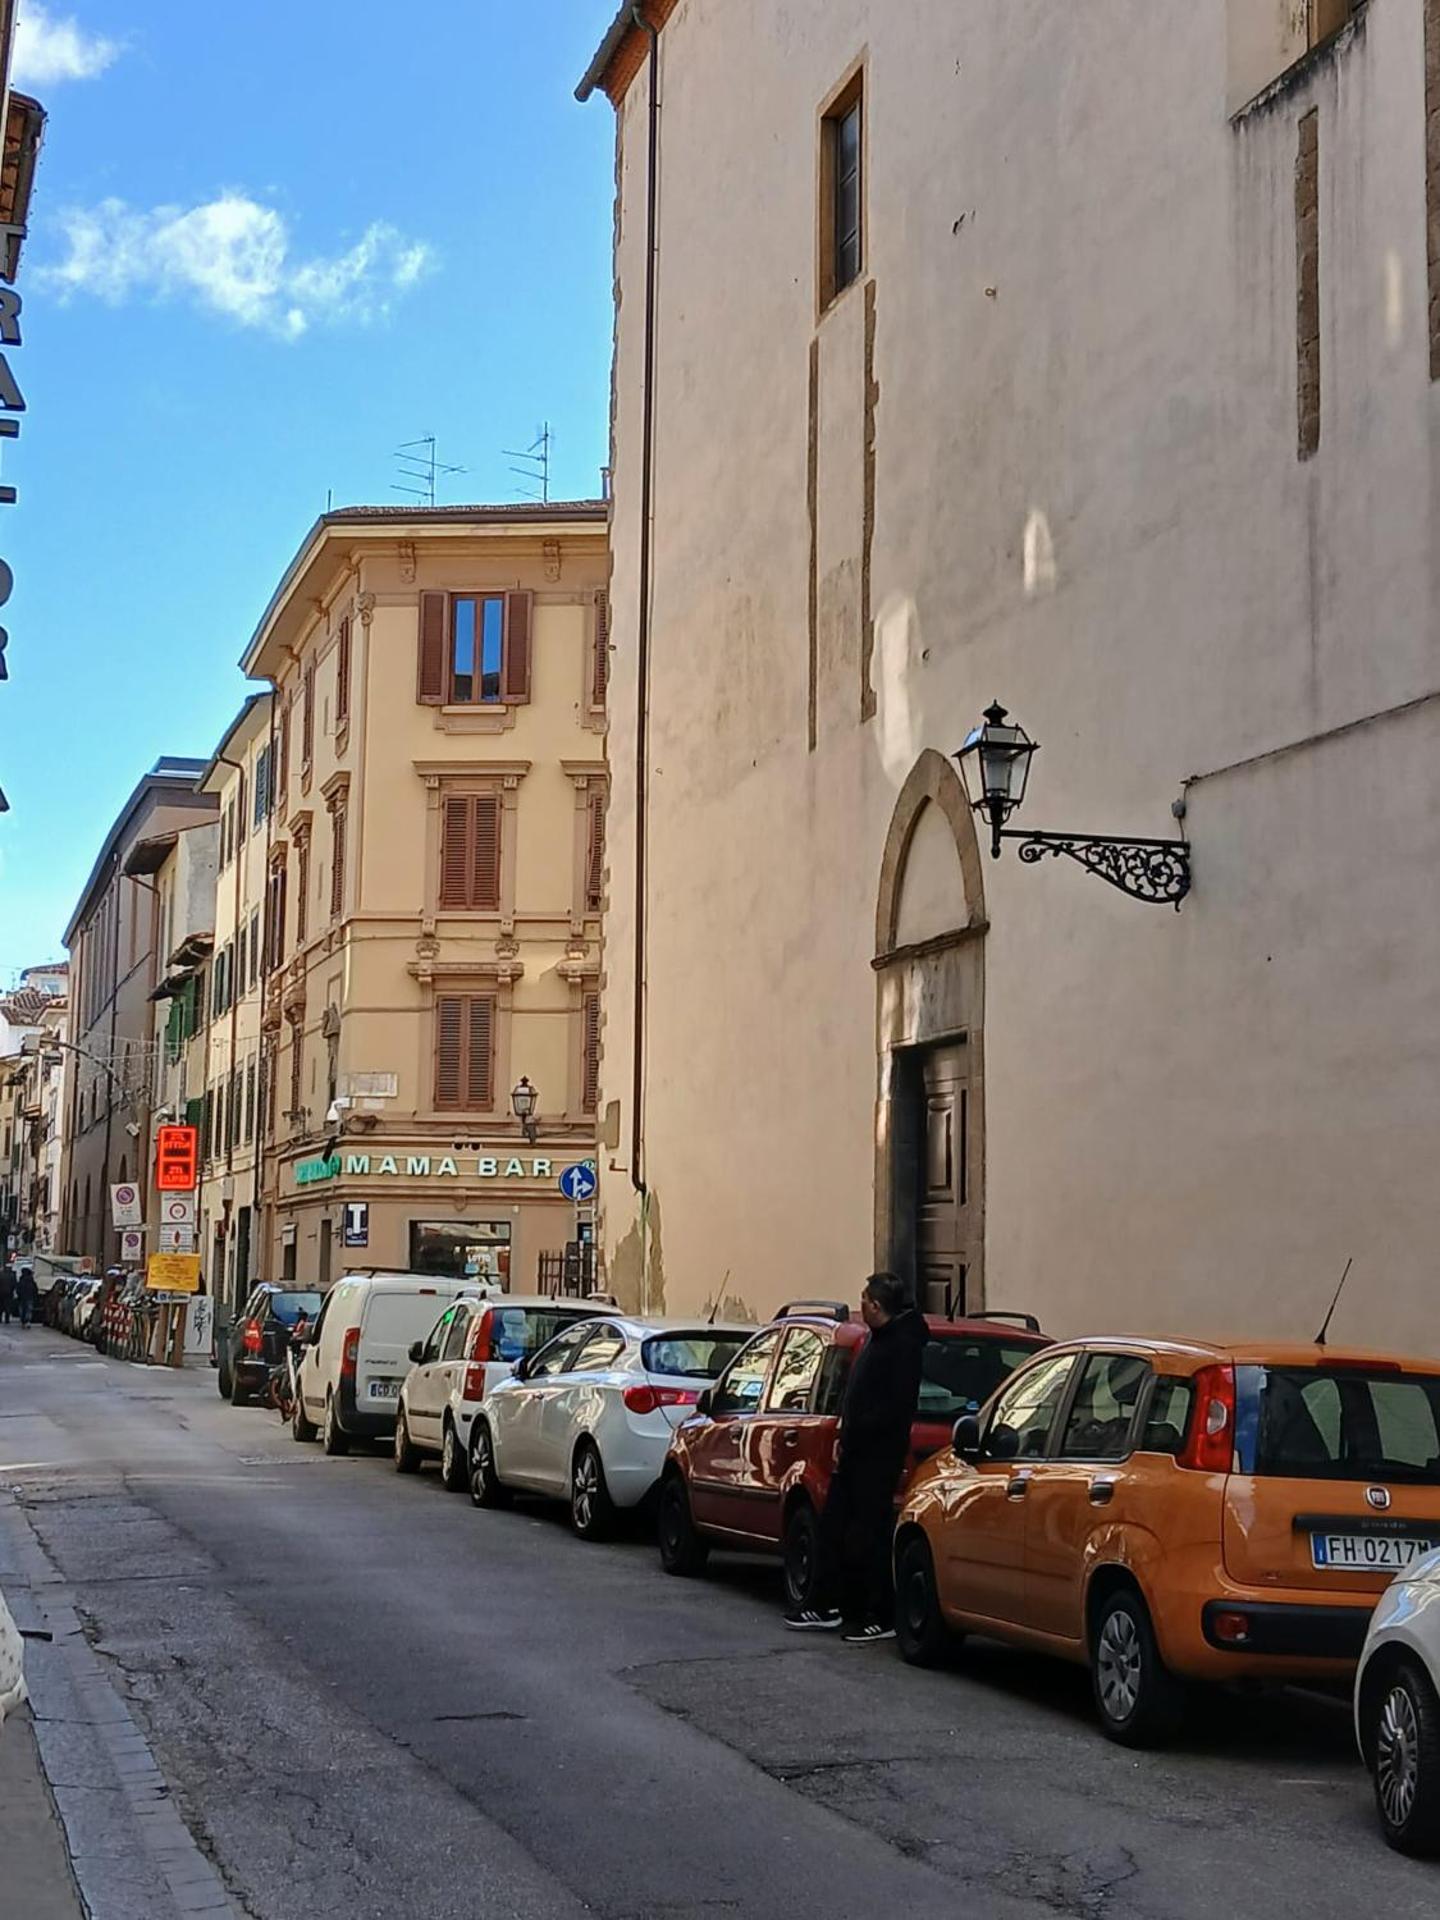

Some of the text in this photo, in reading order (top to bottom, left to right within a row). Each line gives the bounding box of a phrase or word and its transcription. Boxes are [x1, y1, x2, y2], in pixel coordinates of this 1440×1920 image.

[346, 1155, 459, 1177] MAMA
[477, 1157, 553, 1178] BAR
[347, 1203, 367, 1234] T
[1328, 1537, 1357, 1562] FH
